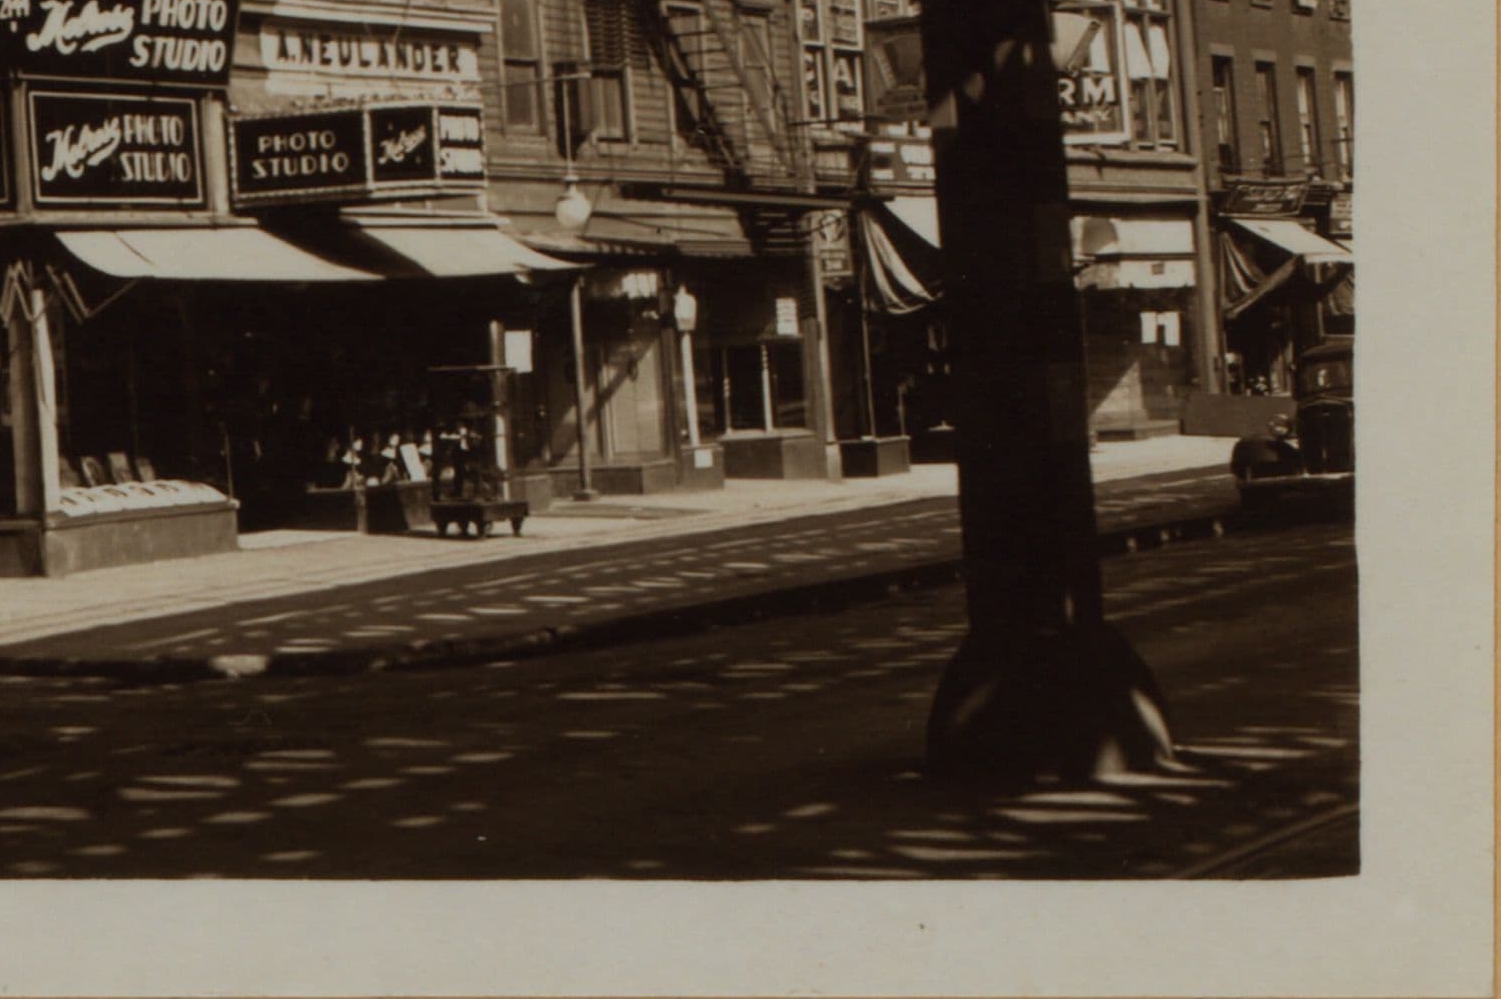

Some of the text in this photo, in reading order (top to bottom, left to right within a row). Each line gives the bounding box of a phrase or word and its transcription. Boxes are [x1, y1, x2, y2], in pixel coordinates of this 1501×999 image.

[26, 0, 134, 55] Melrose
[129, 34, 227, 73] STUDIO
[123, 114, 184, 147] PHOTO
[257, 129, 336, 154] PHOTO
[41, 116, 122, 182] Melrose
[252, 152, 349, 179] STUDIO
[120, 152, 191, 183] STUDIO
